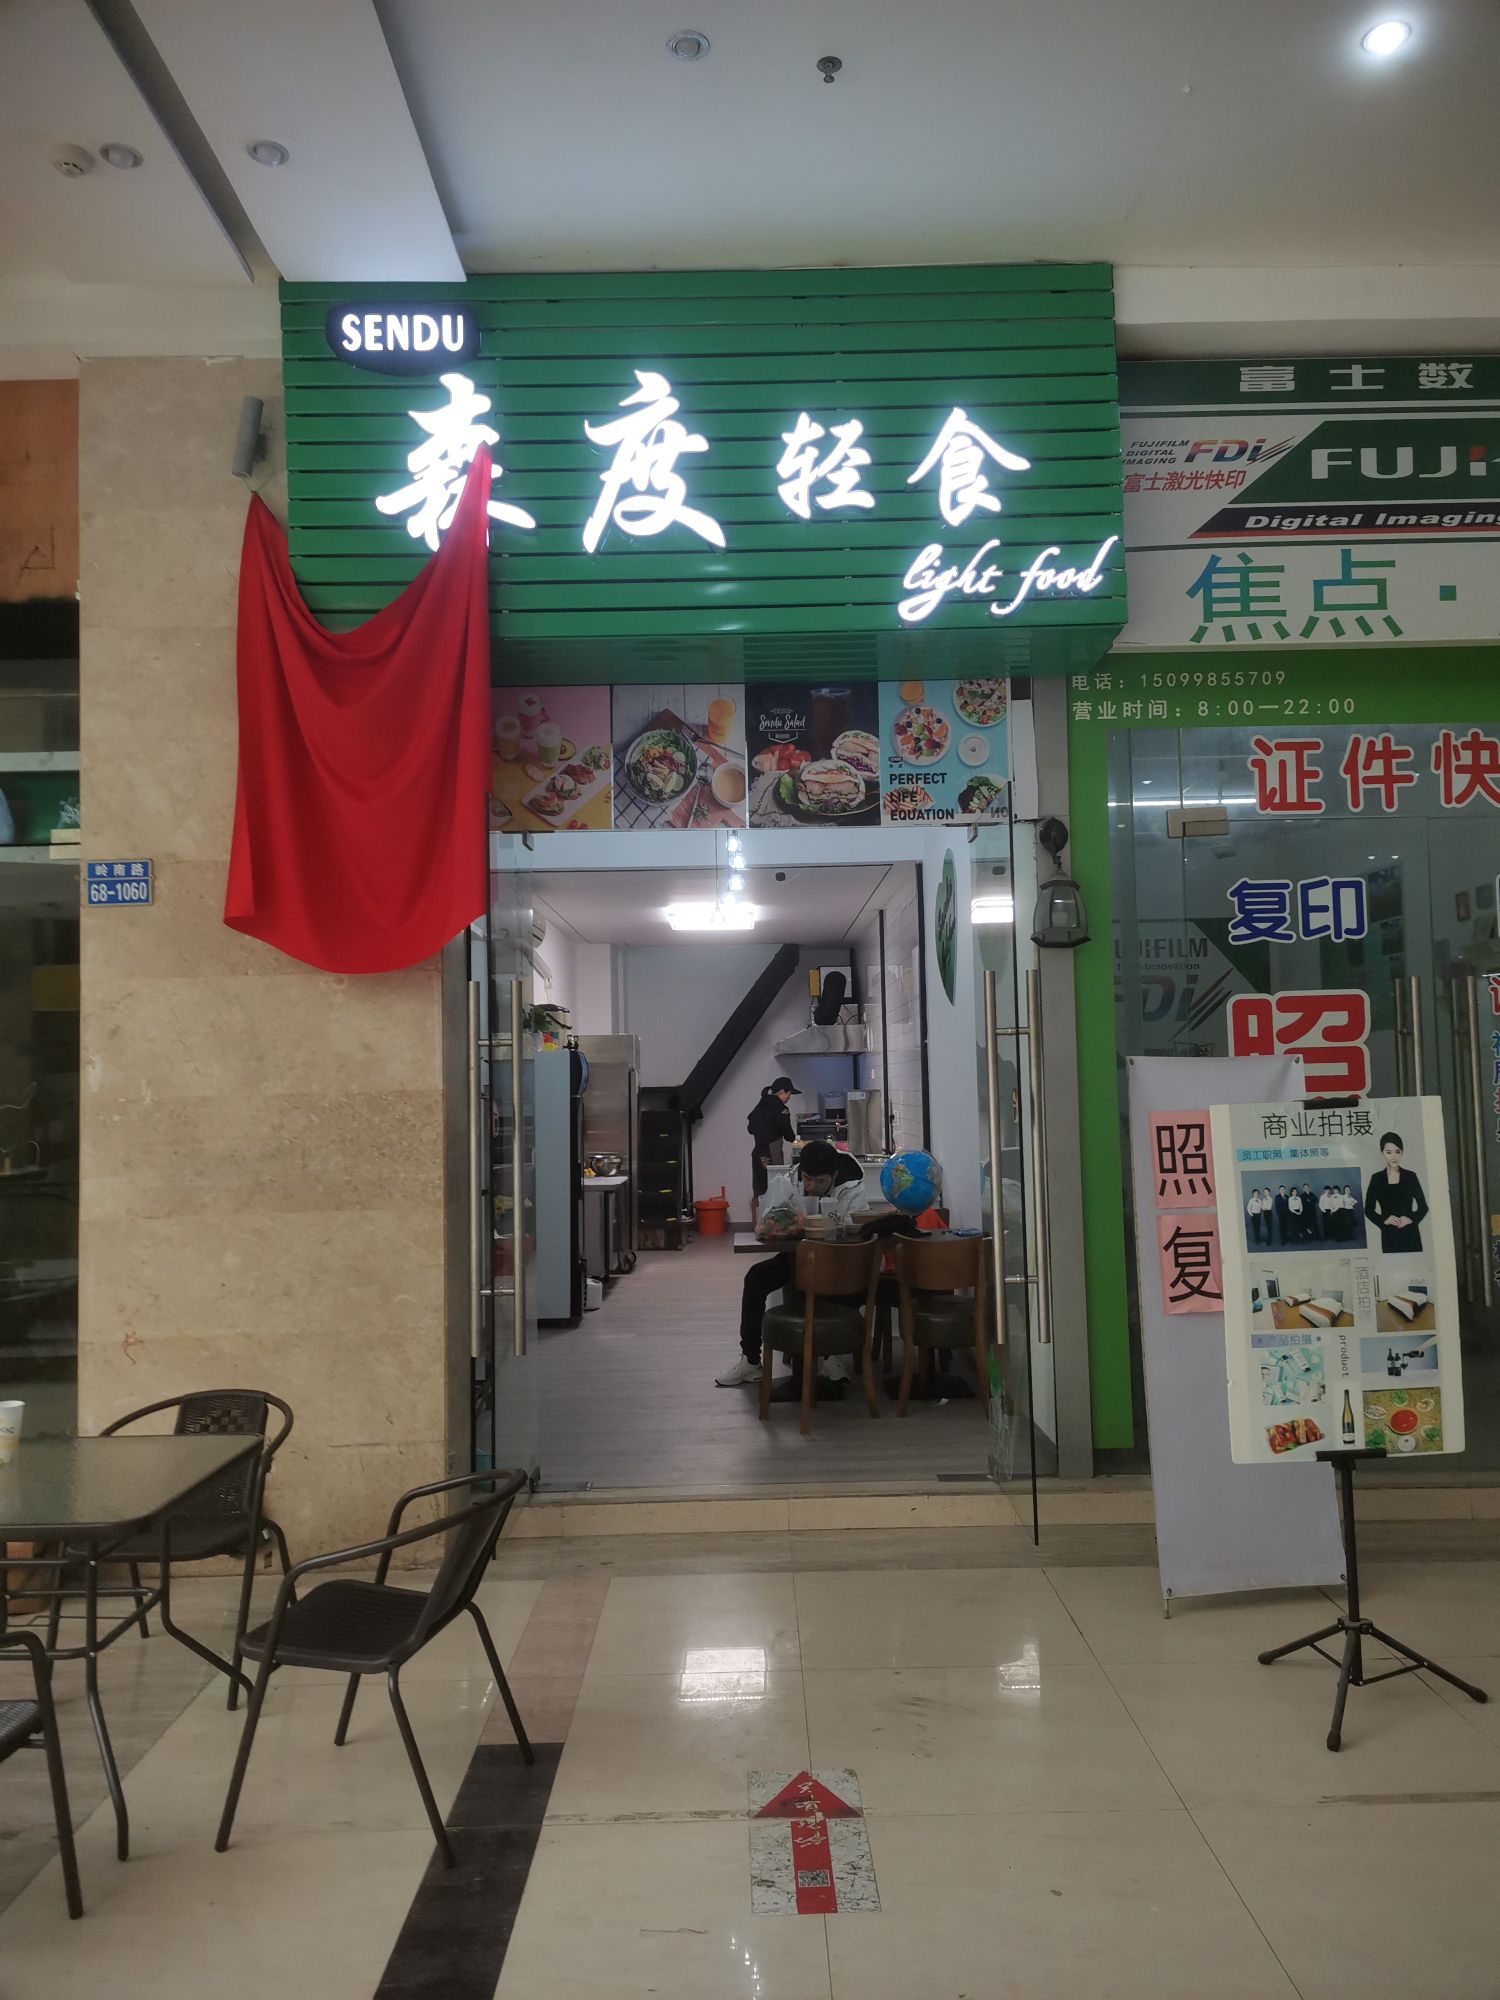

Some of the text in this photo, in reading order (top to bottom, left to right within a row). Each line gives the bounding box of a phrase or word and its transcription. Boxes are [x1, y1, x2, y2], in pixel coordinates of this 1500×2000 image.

[340, 313, 466, 354] SENDU
[1125, 449, 1175, 457] DIGITAL
[1130, 440, 1191, 448] FUJIFILM
[1123, 469, 1247, 494] 富士激光快印
[1244, 512, 1362, 532] Digital
[898, 535, 1119, 624] light food
[784, 713, 806, 730] Salad
[889, 773, 947, 785] PERFECT
[890, 809, 955, 821] EQUATION
[90, 881, 148, 902] 68-1060
[1227, 876, 1368, 945] 复印
[1261, 1110, 1374, 1139] 商业拍摄
[1156, 1123, 1213, 1198] 照
[1162, 1226, 1223, 1303] 复
[1339, 1334, 1350, 1378] product
